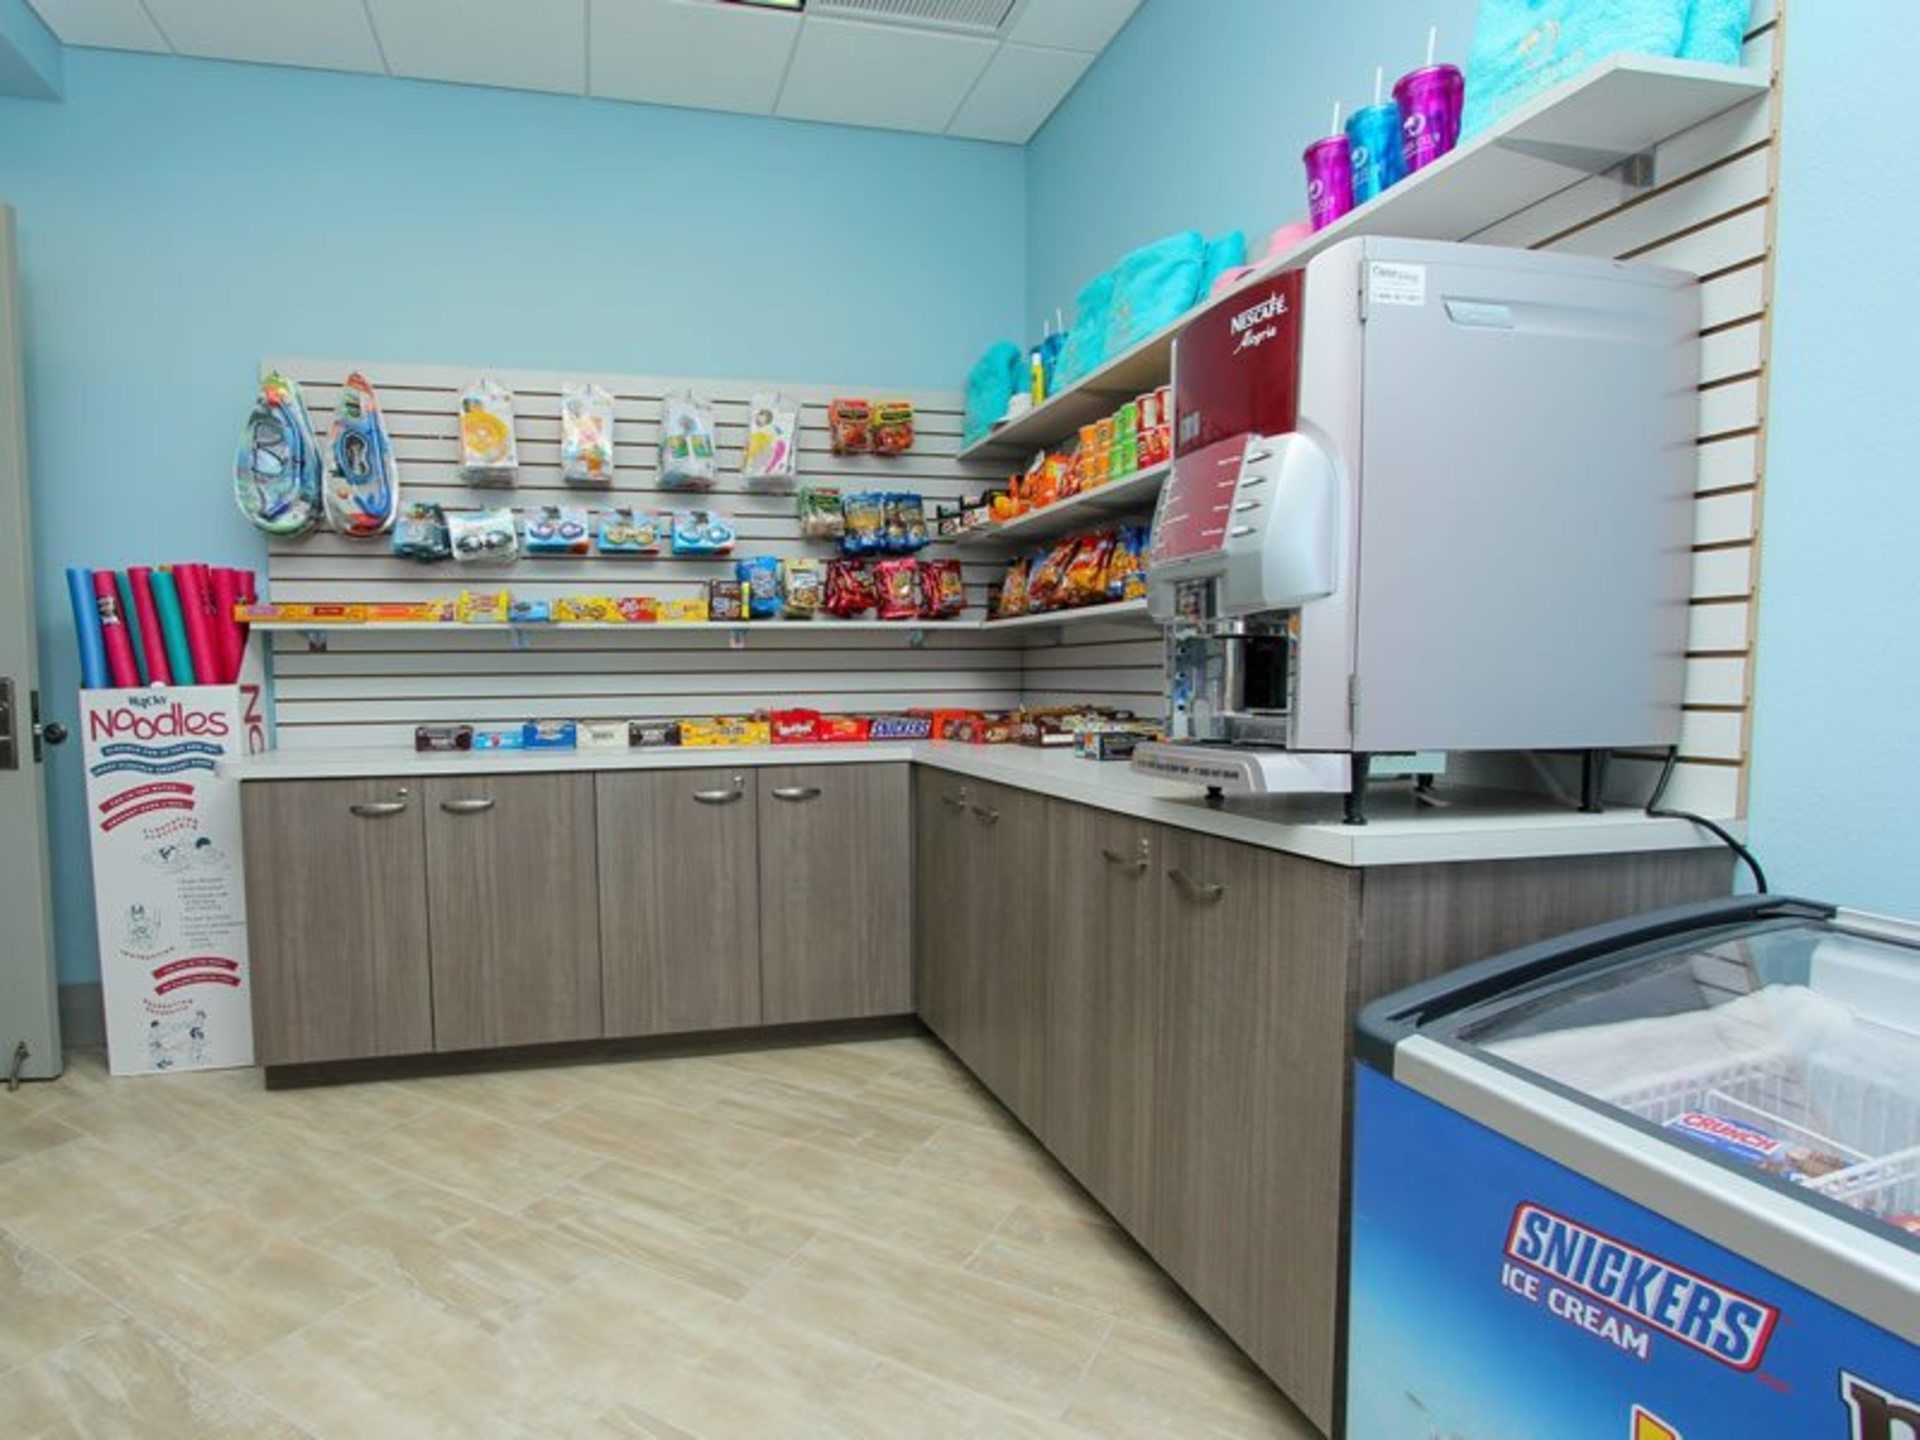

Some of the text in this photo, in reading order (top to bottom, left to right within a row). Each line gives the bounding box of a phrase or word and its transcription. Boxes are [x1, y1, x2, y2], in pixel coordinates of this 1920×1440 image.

[90, 703, 229, 742] Noodles
[1682, 1112, 1780, 1152] CRUNCH
[1501, 1262, 1650, 1360] ICE CREAM
[1516, 1210, 1763, 1360] SNICKERS
